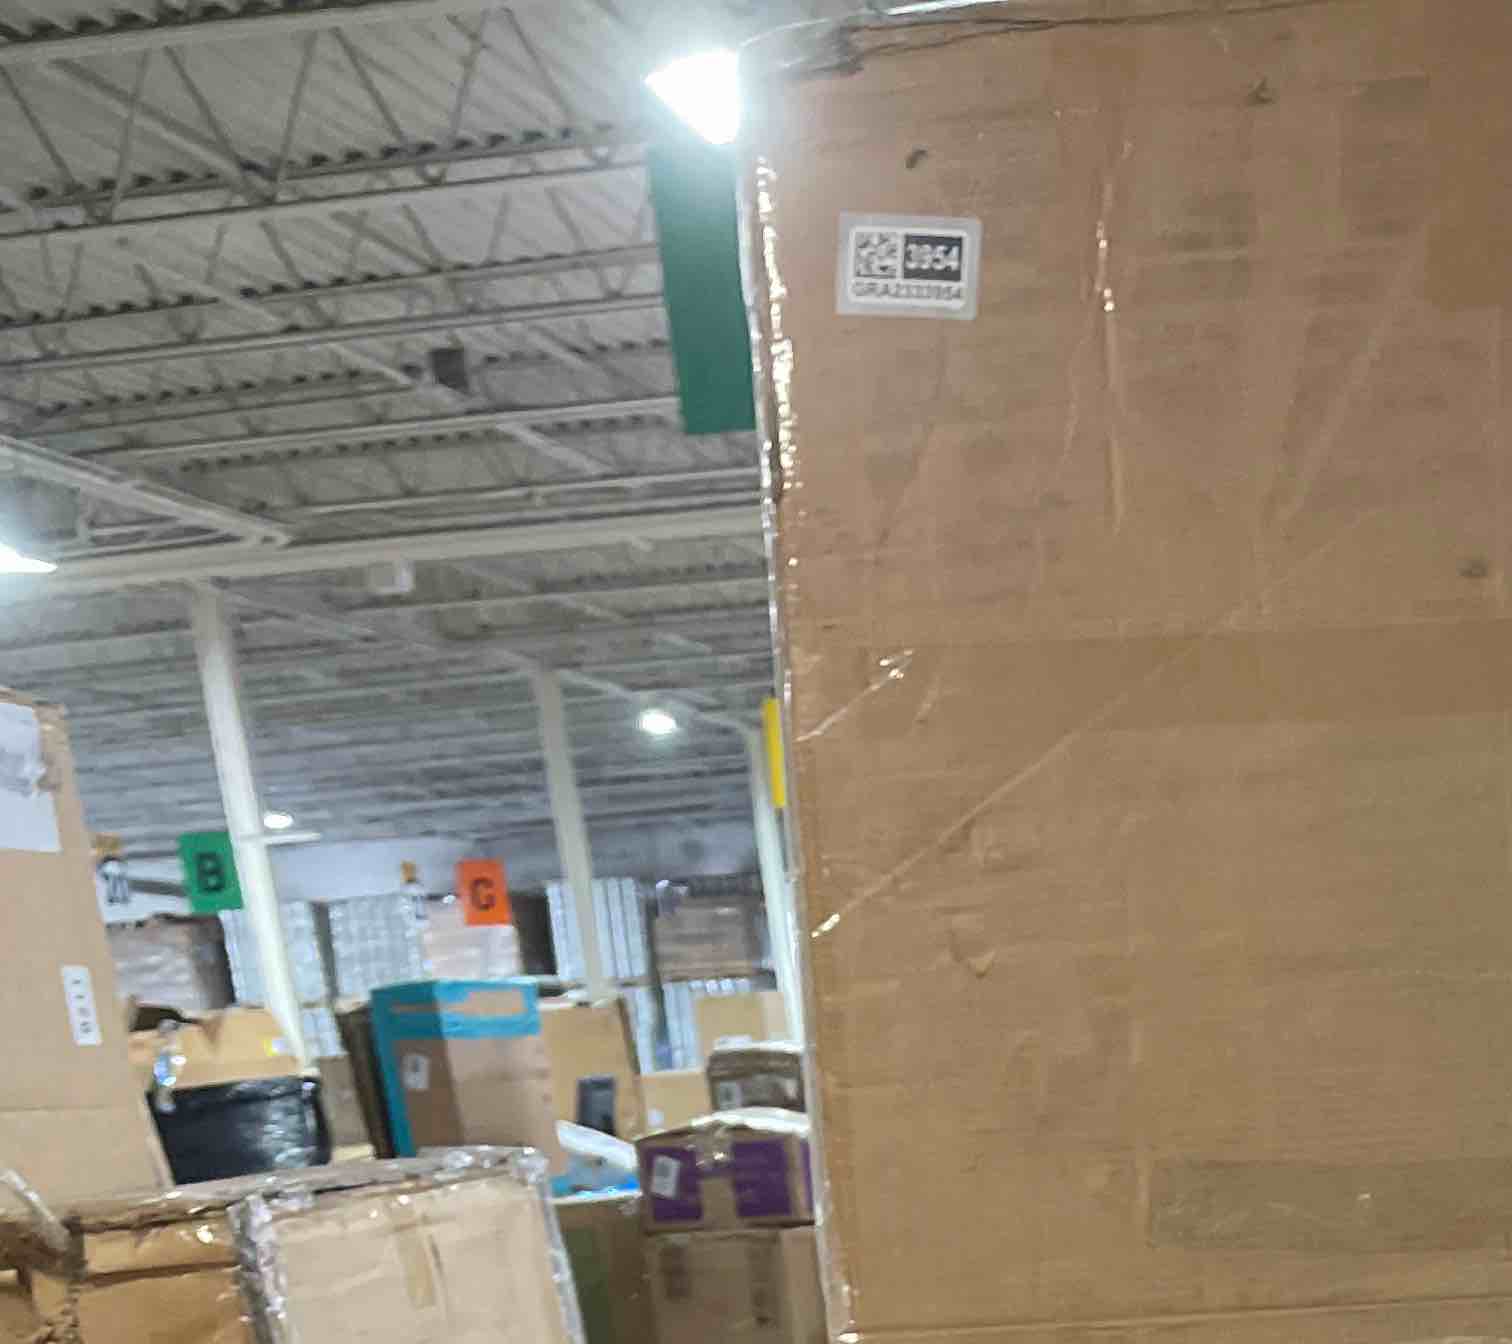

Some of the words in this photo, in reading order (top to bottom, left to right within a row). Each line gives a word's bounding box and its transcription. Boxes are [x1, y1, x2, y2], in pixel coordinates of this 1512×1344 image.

[905, 243, 960, 271] 3954
[194, 851, 225, 892] B
[469, 877, 497, 912] G
